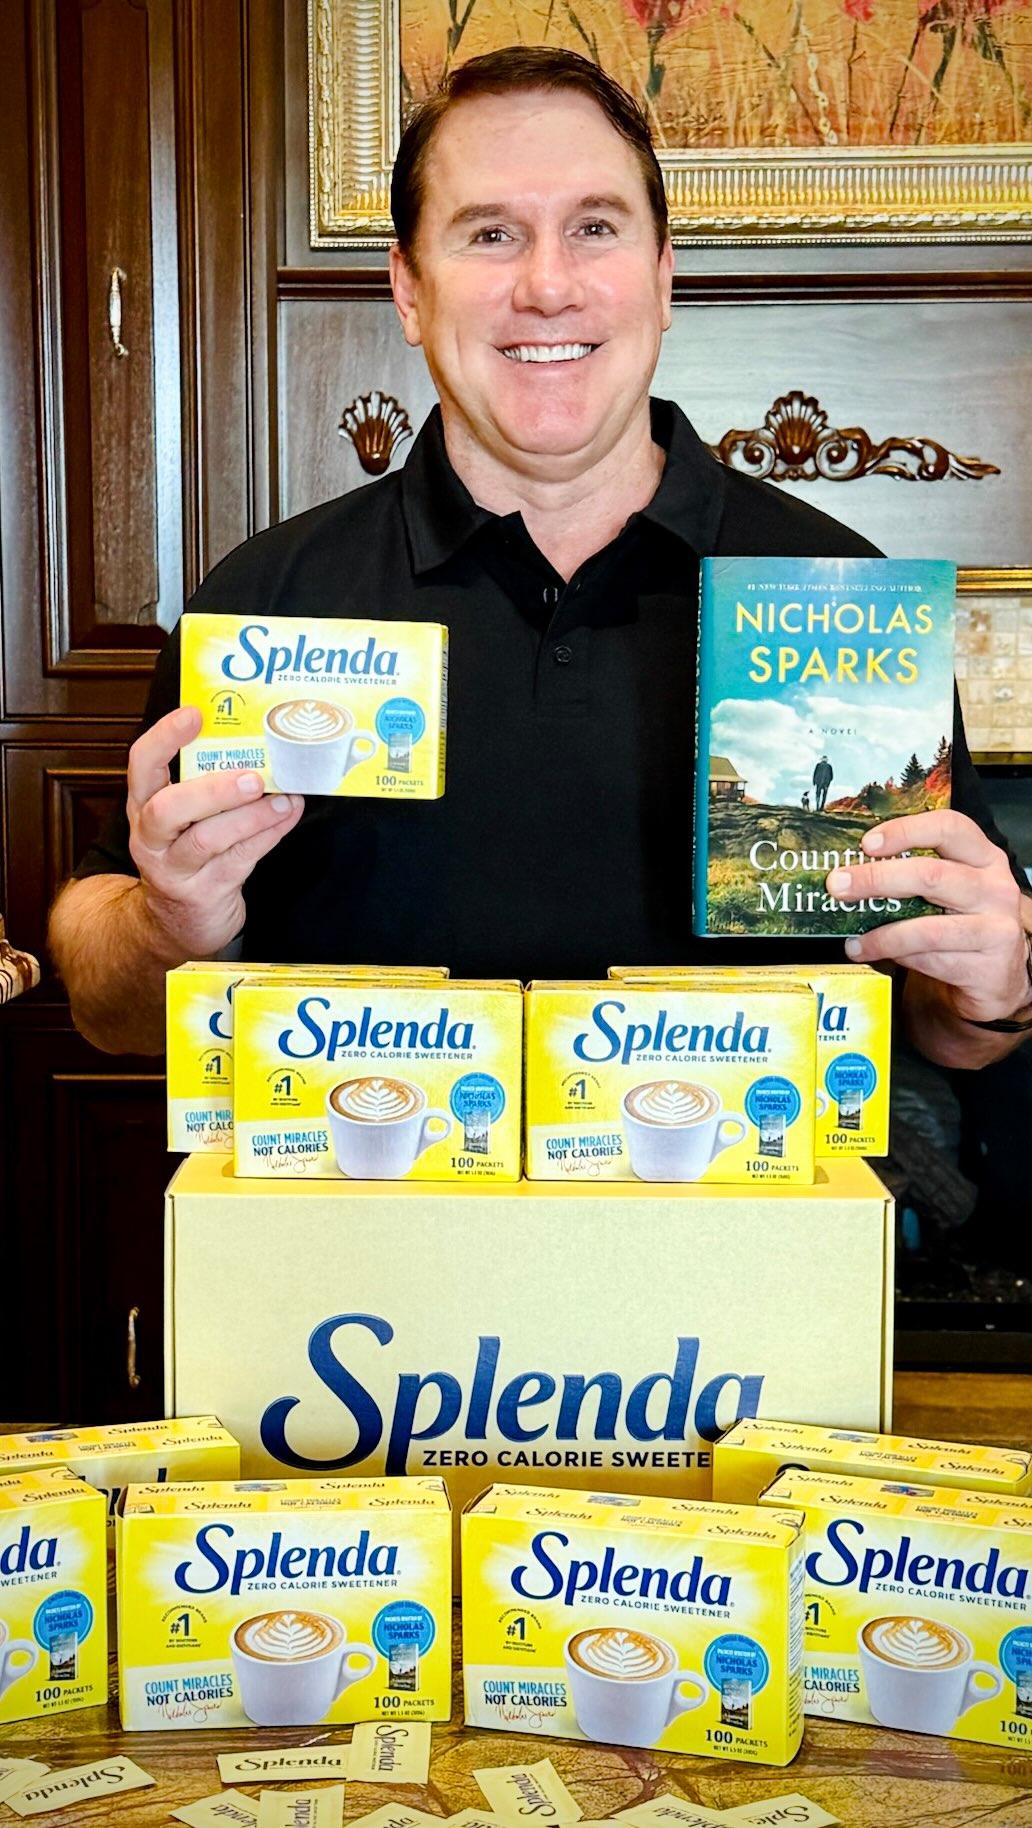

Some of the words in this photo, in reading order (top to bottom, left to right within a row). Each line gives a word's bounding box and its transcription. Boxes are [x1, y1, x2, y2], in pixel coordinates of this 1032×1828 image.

[735, 602, 934, 635] NICHOLAS
[221, 625, 398, 685] Splenda
[749, 646, 919, 684] SPARKS
[278, 674, 301, 682] ZERO
[344, 677, 397, 685] SWEETENER
[217, 697, 233, 717] #1
[197, 750, 223, 762] COUNT
[225, 748, 265, 761] MIRACLES
[198, 762, 216, 772] NOT
[219, 759, 265, 771] CALORIES
[375, 775, 396, 786] 100
[278, 996, 474, 1062] Splenda
[573, 1000, 770, 1065] Splenda
[341, 1050, 367, 1058] ZERO
[370, 1050, 412, 1059] CALORIE
[414, 1051, 473, 1060] SWEETENER
[636, 1054, 662, 1062] ZERO
[665, 1054, 707, 1063] CALORIE
[709, 1055, 768, 1064] SWEETENER
[205, 1056, 221, 1075] #1
[274, 1075, 291, 1096] #1
[568, 1079, 585, 1100] #1
[185, 1111, 212, 1123] COUNT
[186, 1122, 205, 1133] NOT
[252, 1132, 281, 1146] COUNT
[284, 1130, 328, 1144] MIRACLES
[546, 1136, 577, 1150] COUNT
[579, 1134, 623, 1148] MIRACLES
[825, 1134, 847, 1144] 100
[253, 1145, 275, 1157] NOT
[277, 1141, 329, 1155] CALORIES
[547, 1148, 570, 1160] NOT
[571, 1145, 623, 1158] CALORIES
[451, 1157, 474, 1168] 100
[746, 1161, 769, 1171] 100
[259, 1312, 766, 1476] Splenda
[162, 1434, 224, 1446] Splenda
[423, 1450, 489, 1467] ZERO
[496, 1449, 603, 1468] CALORIE
[611, 1450, 710, 1468] SWEETE
[940, 1462, 1005, 1475] Splenda
[138, 1485, 205, 1494] Splenda
[320, 1482, 385, 1490] Splenda
[22, 1487, 87, 1503] Splenda
[369, 1498, 435, 1507] Splenda
[821, 1494, 888, 1509] Splenda
[184, 1501, 252, 1510] Splenda
[526, 1507, 592, 1520] Splenda
[672, 1503, 740, 1515] Splenda
[707, 1525, 776, 1539] Splenda
[174, 1523, 398, 1595] Splenda
[805, 1518, 1029, 1599] Splenda
[510, 1530, 732, 1606] Splenda
[0, 1571, 57, 1587] WEETENER
[247, 1581, 276, 1590] ZERO
[281, 1580, 328, 1590] CALORIE
[331, 1579, 398, 1589] SWEETENER
[875, 1582, 904, 1594] ZERO
[908, 1587, 956, 1601] CALORIE
[959, 1594, 1027, 1611] SWEETENER
[581, 1594, 610, 1605] ZERO
[613, 1598, 660, 1610] CALORIE
[663, 1602, 731, 1618] SWEETENER
[170, 1613, 190, 1637] #1
[383, 1621, 425, 1632] NICHOLAS
[506, 1616, 525, 1640] #1
[388, 1630, 420, 1640] SPARKS
[716, 1656, 758, 1668] NICHOLAS
[720, 1664, 753, 1676] SPARKS
[811, 1666, 860, 1682] MIRACLES
[145, 1680, 179, 1695] COUNT
[182, 1673, 233, 1690] MIRACLES
[484, 1680, 516, 1695] COUNT
[518, 1681, 567, 1696] MIRACLES
[804, 1679, 860, 1693] CALORIES
[35, 1686, 61, 1702] 100
[63, 1684, 94, 1696] PACKETS
[147, 1693, 170, 1706] NOT
[174, 1686, 234, 1703] CALORIES
[373, 1696, 401, 1708] 100
[403, 1699, 435, 1707] PACKETS
[484, 1695, 505, 1706] NOT
[510, 1695, 567, 1708] CALORIES
[1000, 1720, 1028, 1736] 100
[706, 1729, 733, 1744] 100
[735, 1737, 768, 1748] PACKETS
[375, 1724, 409, 1772] Splenda
[235, 1756, 341, 1771] Splenda
[25, 1765, 126, 1801] Splenda
[506, 1773, 557, 1817] Splenda
